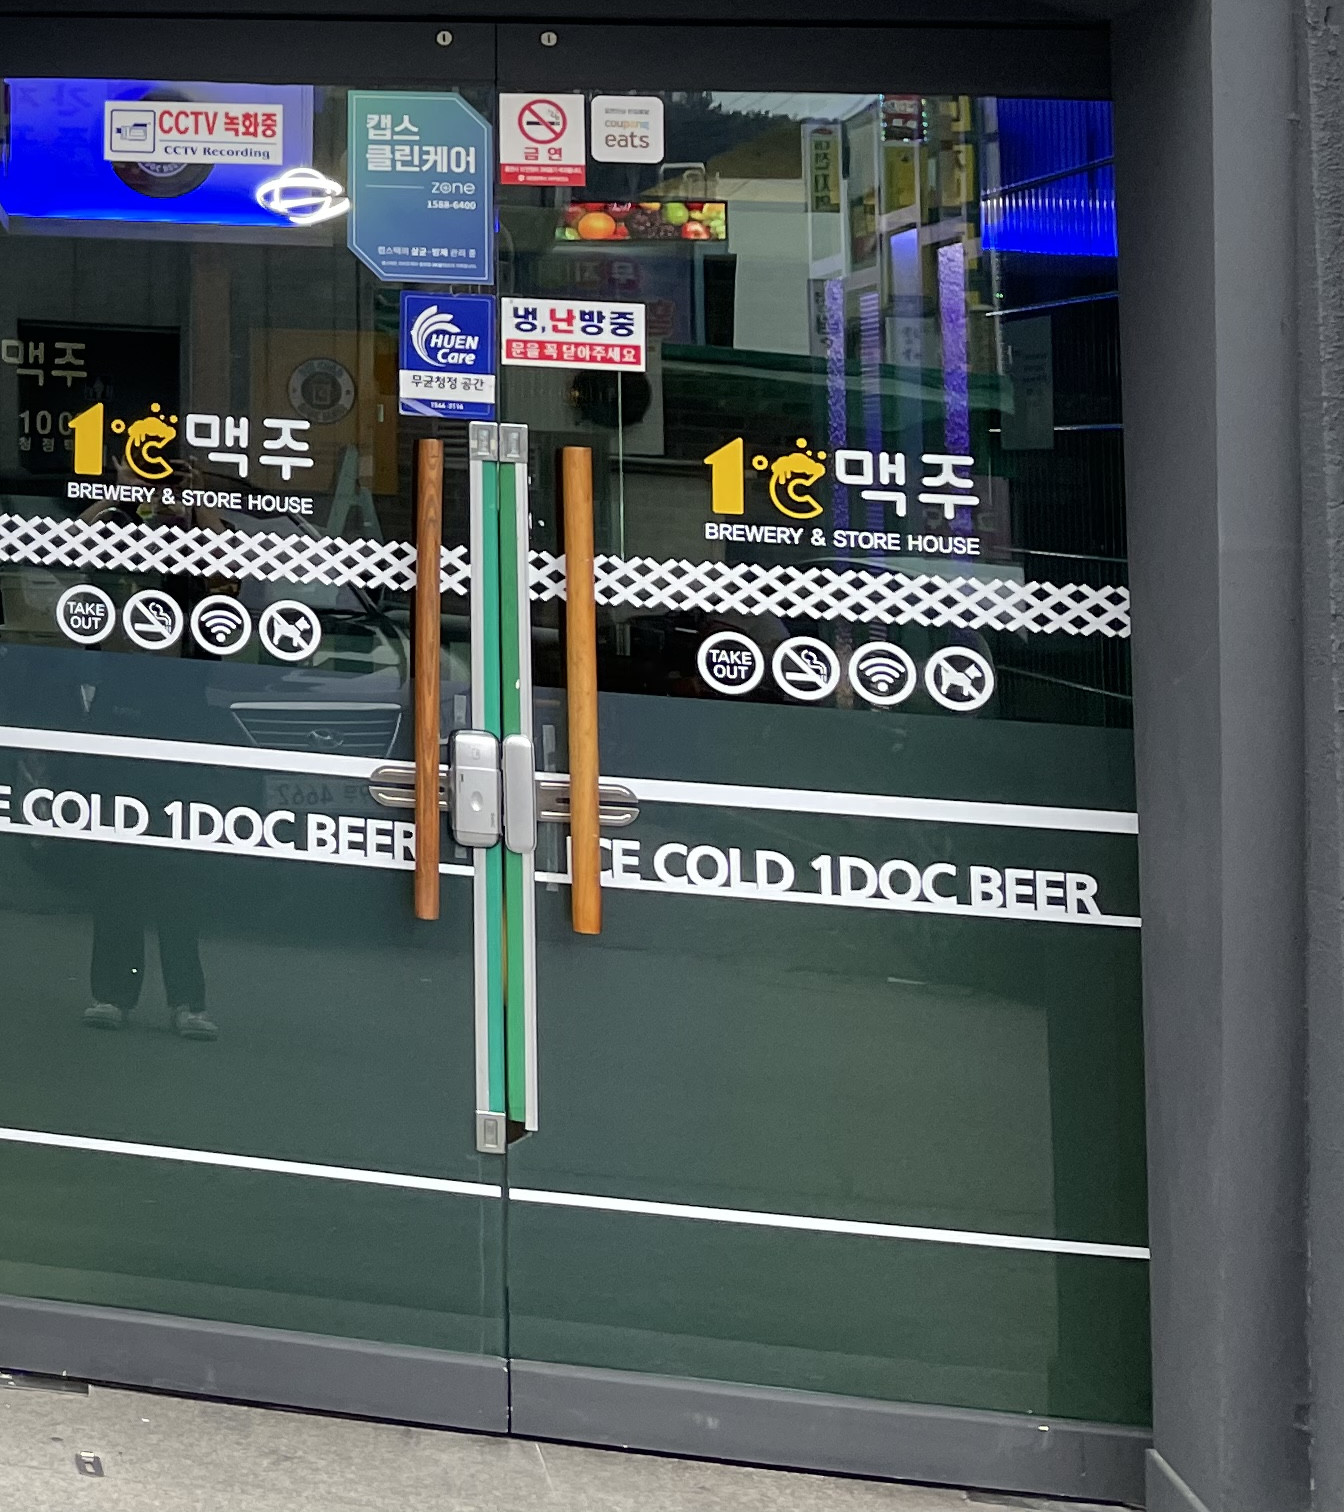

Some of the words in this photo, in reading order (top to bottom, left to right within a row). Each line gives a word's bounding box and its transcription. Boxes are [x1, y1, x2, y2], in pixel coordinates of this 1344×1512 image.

[158, 110, 218, 136] CCTV
[224, 112, 278, 138] 녹화중
[366, 113, 420, 141] 캡스
[604, 132, 650, 148] eats
[164, 145, 198, 156] CCTV
[203, 147, 271, 160] Recording
[366, 144, 476, 174] 클린케어
[430, 333, 479, 350] HUEN
[511, 342, 540, 359] 문을
[544, 343, 558, 359] 꼭
[562, 345, 637, 363] 닫아주세요
[1, 339, 88, 387] 맥주
[437, 349, 476, 365] Care
[411, 374, 458, 390] 무균청정
[461, 377, 486, 392] 공간
[185, 414, 315, 481] 맥주
[835, 449, 980, 520] 맥주
[67, 482, 155, 505] BREWERY
[161, 488, 176, 505] &
[182, 490, 242, 510] STORE
[248, 494, 314, 515] HOUSE
[705, 522, 803, 546] BREWERY
[811, 529, 826, 546] &
[833, 531, 901, 552] STORE
[907, 534, 980, 556] HOUSE
[67, 601, 105, 619] TAKE
[70, 615, 102, 632] OUT
[709, 649, 753, 666] TAKE
[713, 663, 749, 680] OUT
[23, 789, 149, 836] COLD
[164, 801, 296, 850] 1DOC
[654, 843, 795, 893] COLD
[811, 855, 957, 906] 1DOC
[968, 865, 1101, 916] BEER
